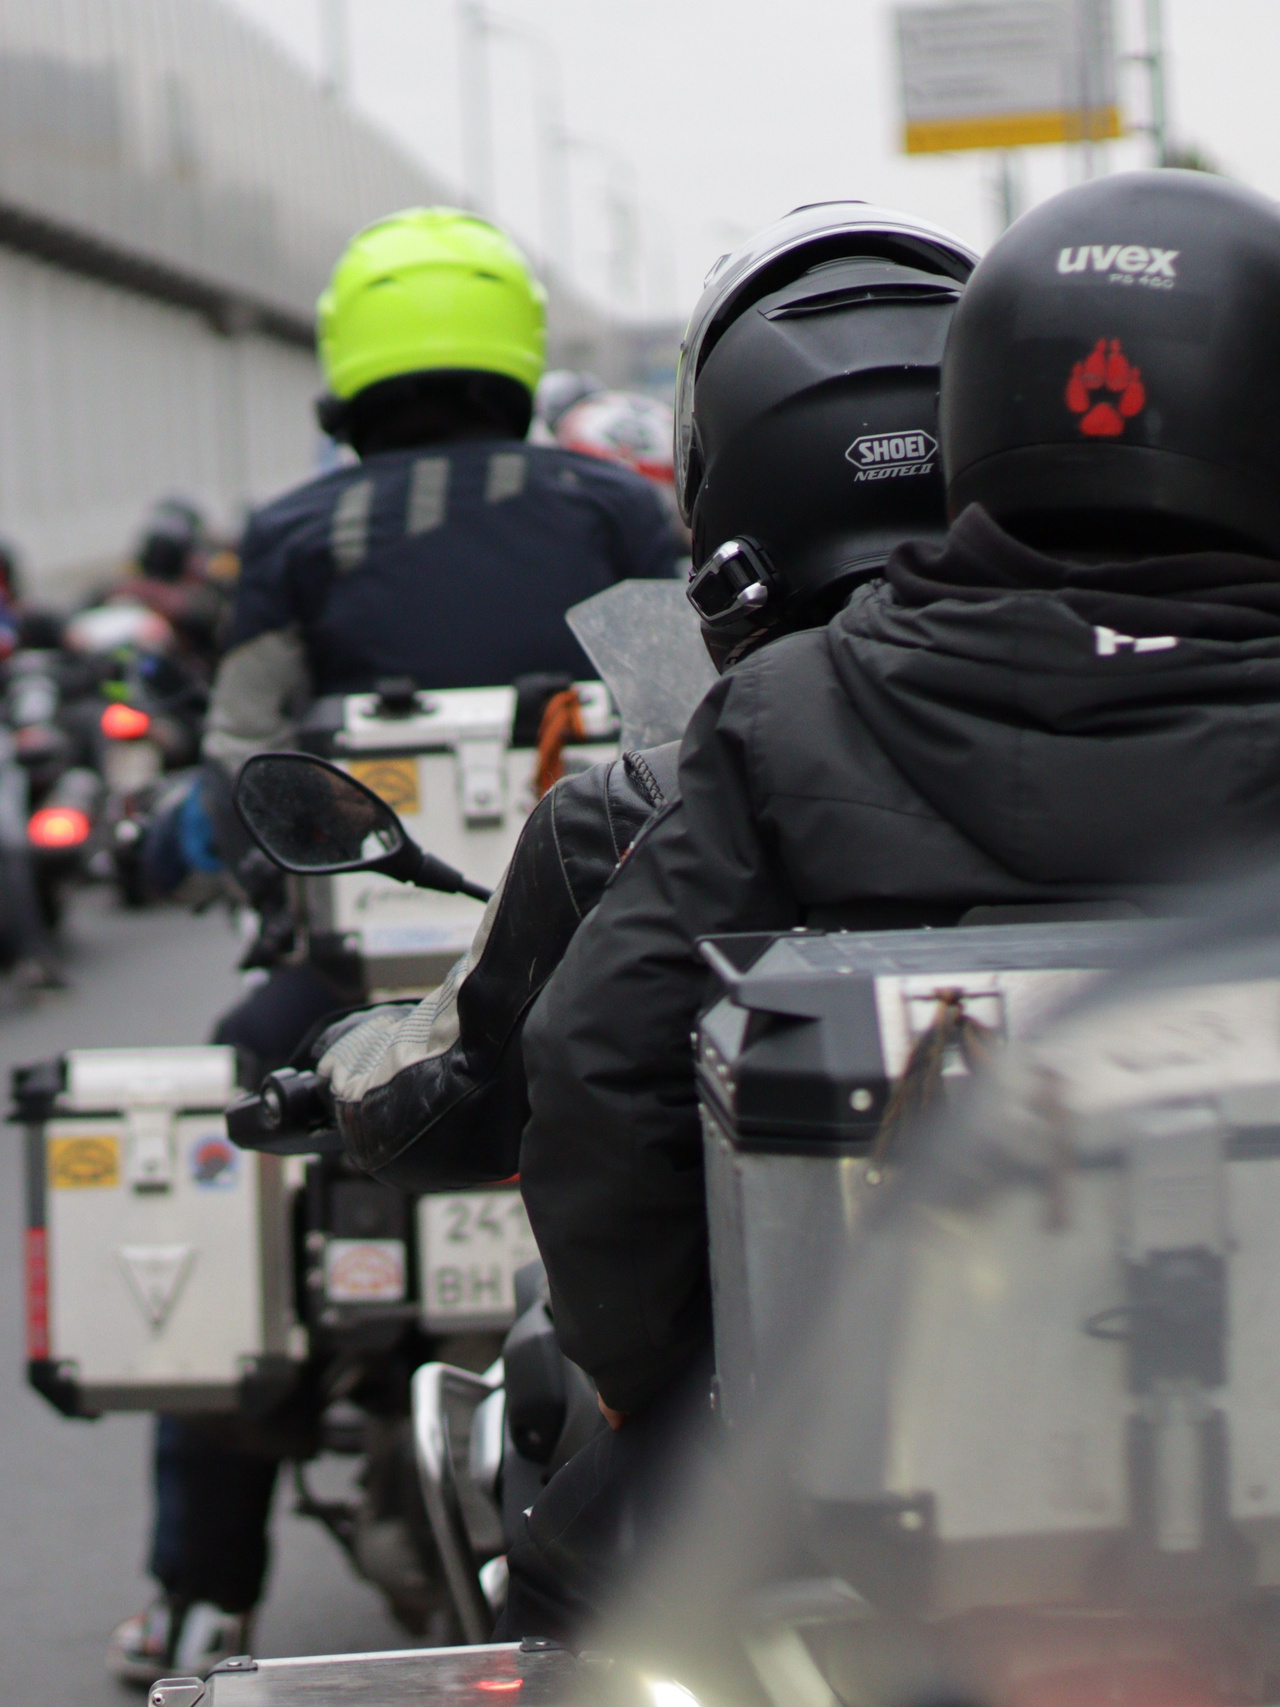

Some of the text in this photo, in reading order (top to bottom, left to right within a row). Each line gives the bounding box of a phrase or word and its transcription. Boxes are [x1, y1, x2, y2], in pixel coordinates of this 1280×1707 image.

[1057, 245, 1179, 274] uvex
[858, 436, 926, 463] SHOEI
[854, 464, 920, 482] NEOTEC
